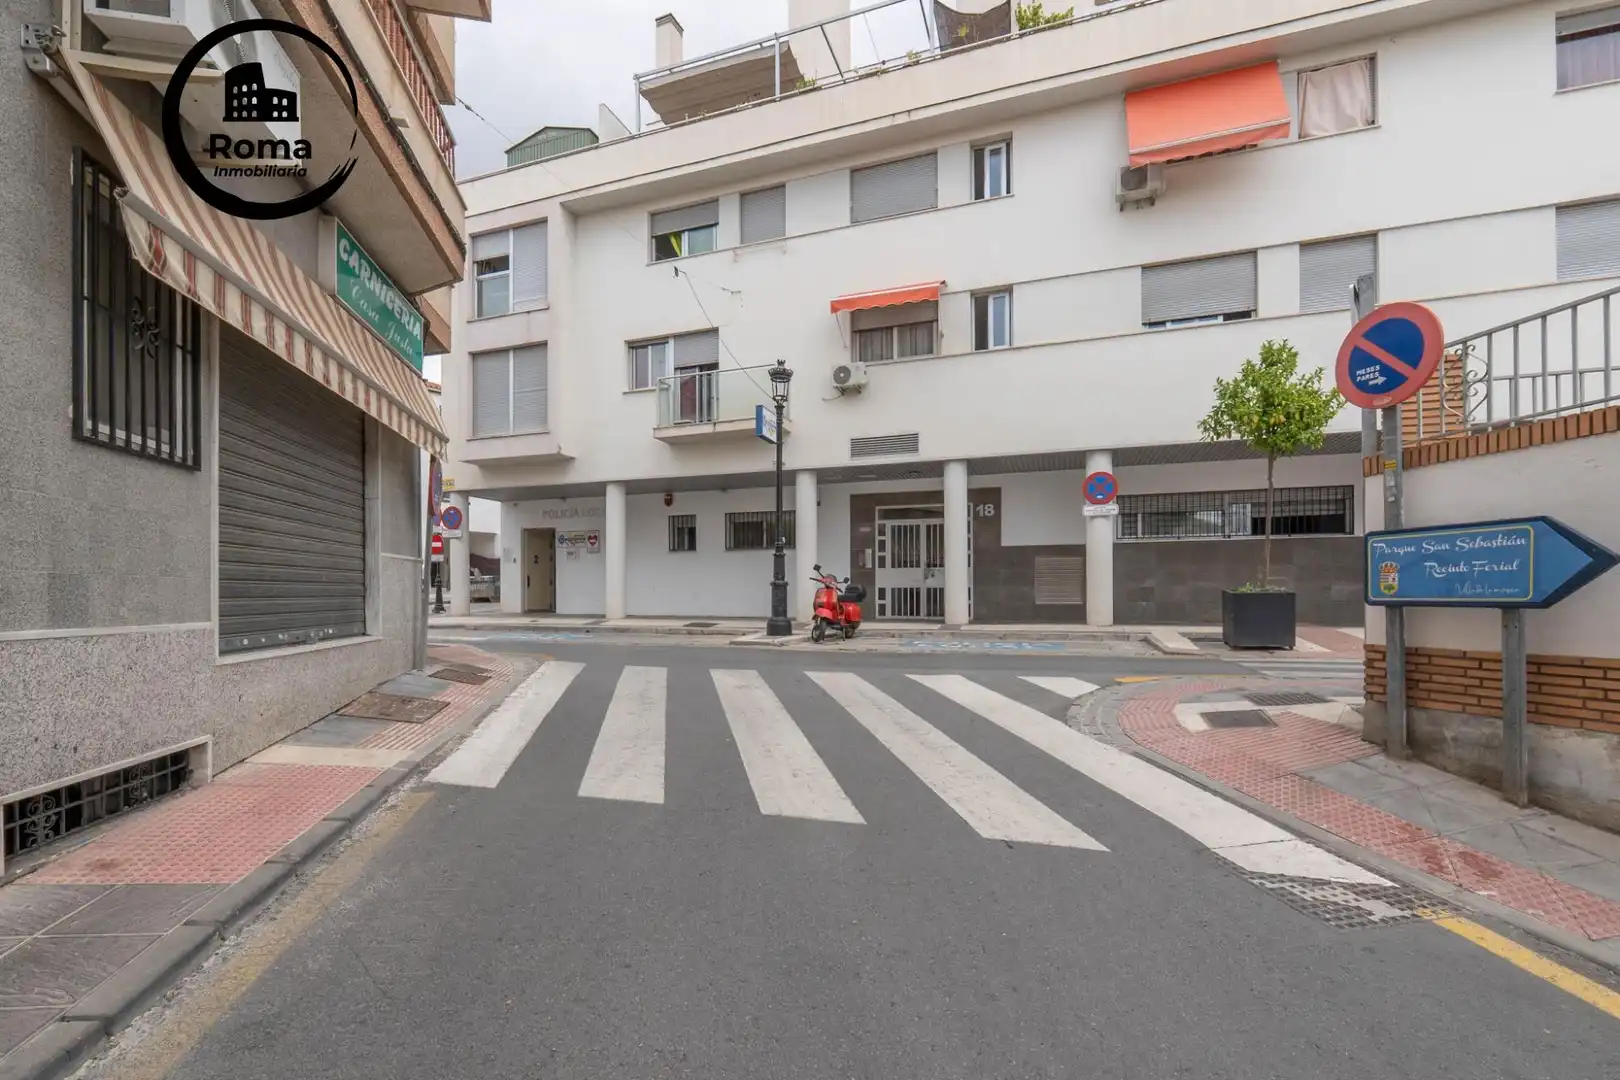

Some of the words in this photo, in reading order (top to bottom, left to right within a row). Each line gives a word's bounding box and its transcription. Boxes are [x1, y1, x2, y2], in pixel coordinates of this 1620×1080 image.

[339, 237, 422, 341] CARNICERIA
[1356, 364, 1381, 376] MESES
[1356, 371, 1380, 382] PARES
[975, 503, 995, 517] 18
[1373, 543, 1417, 559] Parque
[1421, 539, 1451, 554] San
[1455, 534, 1528, 552] Sebastián
[1424, 561, 1470, 578] Recinto
[1472, 559, 1521, 578] Ferial
